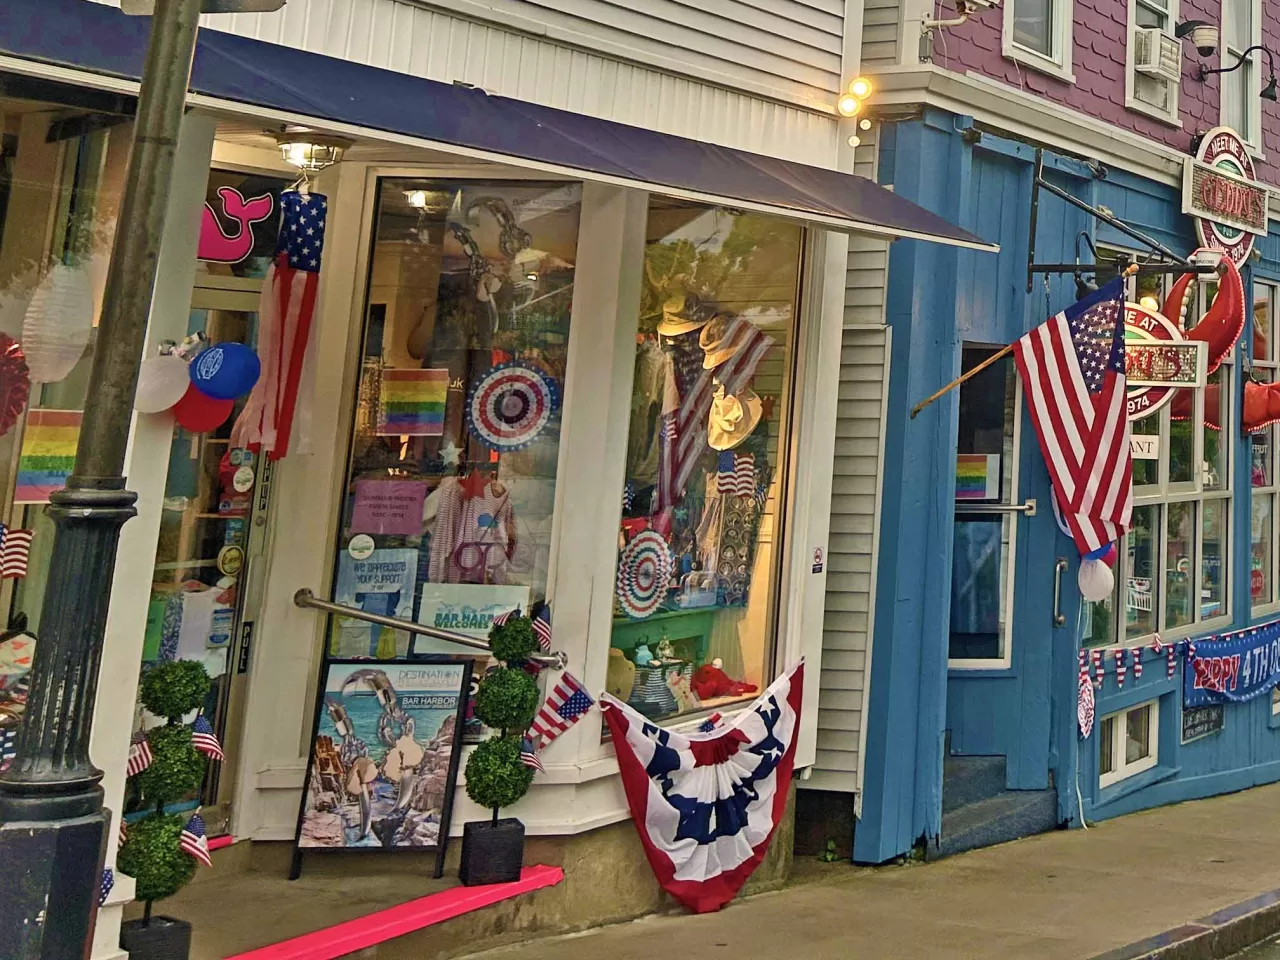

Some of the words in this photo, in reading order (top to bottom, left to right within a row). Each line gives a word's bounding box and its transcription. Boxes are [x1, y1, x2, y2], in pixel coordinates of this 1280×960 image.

[1211, 137, 1230, 155] MEET
[1229, 138, 1239, 156] ME
[1240, 152, 1249, 167] AT
[1139, 315, 1158, 332] AT
[1128, 395, 1150, 413] 974
[435, 613, 459, 621] BAR
[434, 620, 489, 629] WELCOMES
[402, 697, 420, 705] BAR
[420, 696, 457, 706] HARBOR
